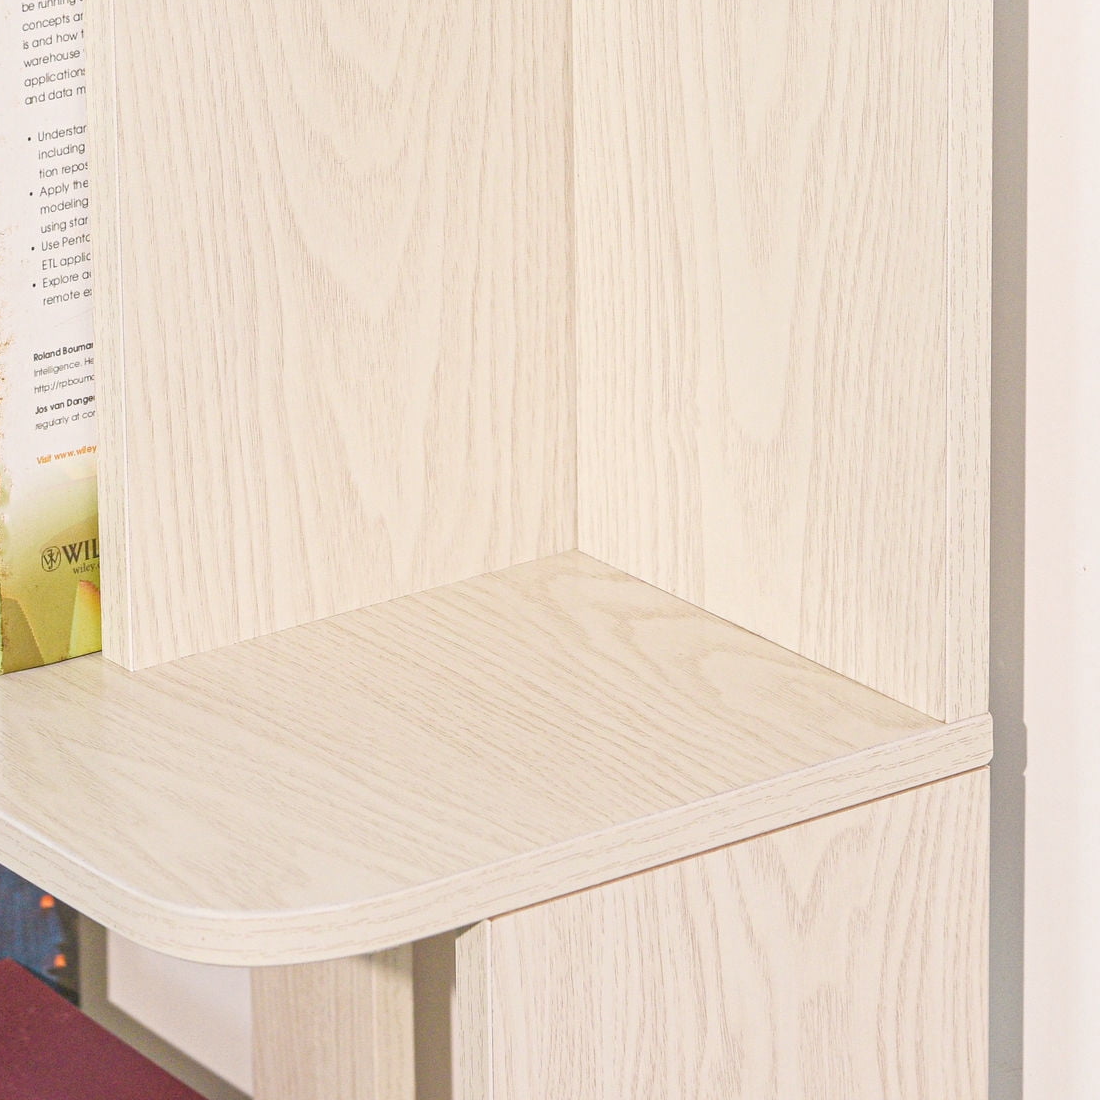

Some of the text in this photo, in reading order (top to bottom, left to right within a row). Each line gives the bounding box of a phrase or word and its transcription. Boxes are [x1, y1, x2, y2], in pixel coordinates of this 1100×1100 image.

[22, 2, 35, 12] be
[22, 14, 70, 31] concepts
[23, 40, 29, 50] is
[32, 34, 52, 48] and
[56, 32, 78, 43] how
[23, 49, 80, 68] warehouse
[24, 68, 85, 88] applications
[25, 92, 45, 105] and
[48, 88, 72, 100] data
[38, 143, 85, 160] including
[39, 168, 58, 179] tion
[40, 179, 89, 197] Apply the
[40, 197, 89, 215] modeling
[40, 221, 67, 234] using
[41, 241, 60, 251] Use
[42, 252, 91, 270] ETL applic
[42, 273, 79, 288] Explore
[43, 290, 80, 306] remote
[33, 347, 61, 362] Roland
[35, 404, 48, 415] Jos
[50, 401, 64, 410] van
[35, 416, 69, 430] regularly
[71, 412, 80, 422] at
[36, 455, 52, 464] Visit
